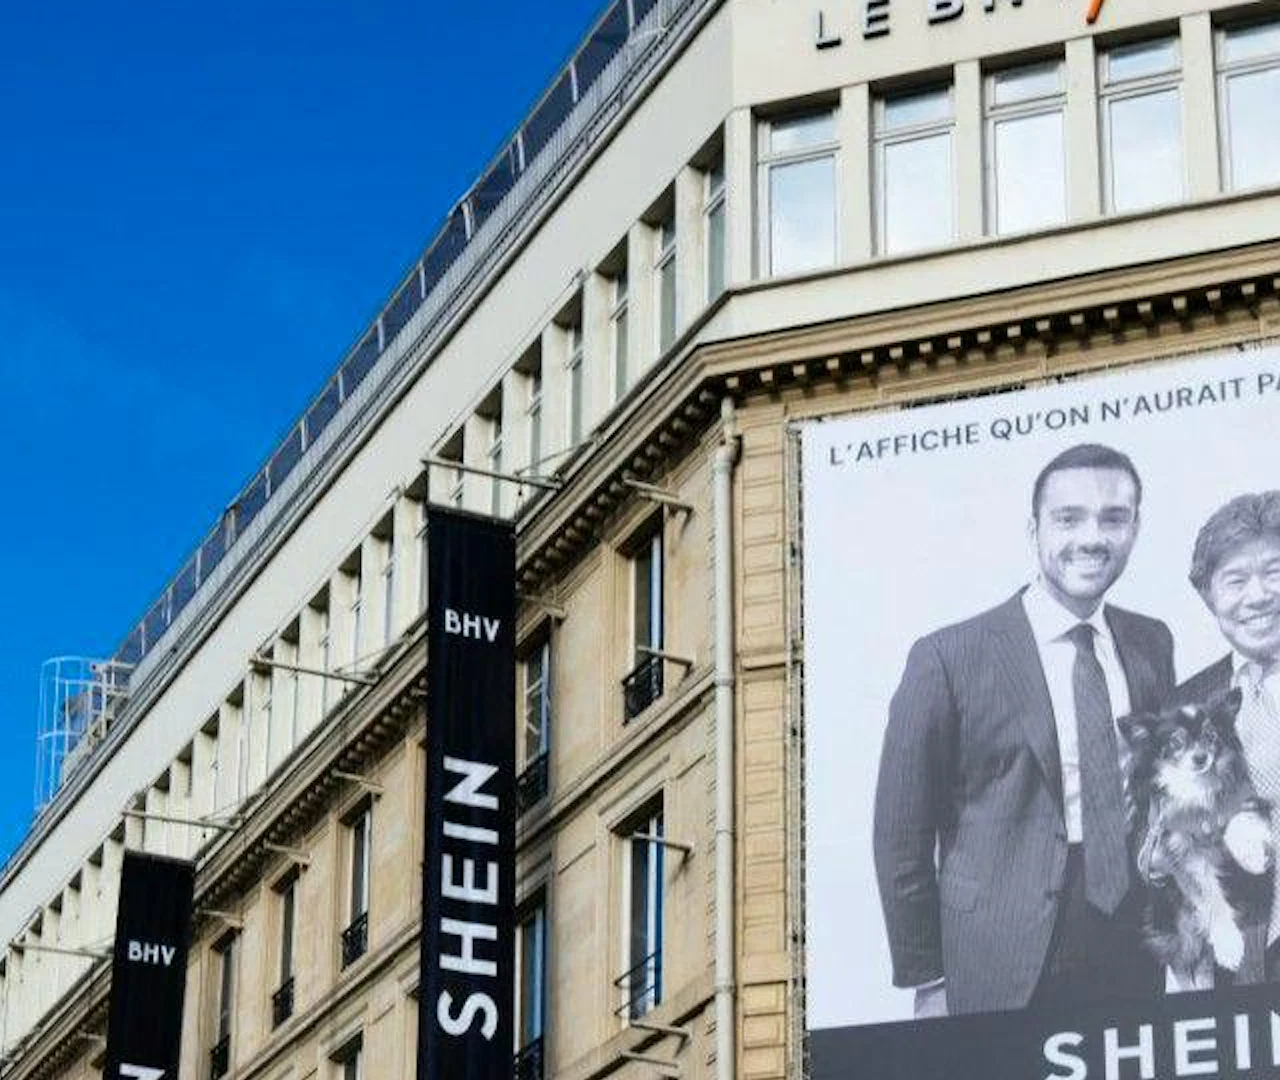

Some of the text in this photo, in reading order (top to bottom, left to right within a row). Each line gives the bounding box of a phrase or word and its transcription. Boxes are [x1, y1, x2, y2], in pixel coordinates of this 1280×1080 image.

[830, 422, 979, 466] L'AFFICHE
[990, 405, 1088, 441] QU'ON
[1101, 377, 1244, 422] N'AURAIT
[444, 608, 500, 643] BHV
[437, 756, 499, 1040] SHEIN
[128, 940, 176, 967] BHV
